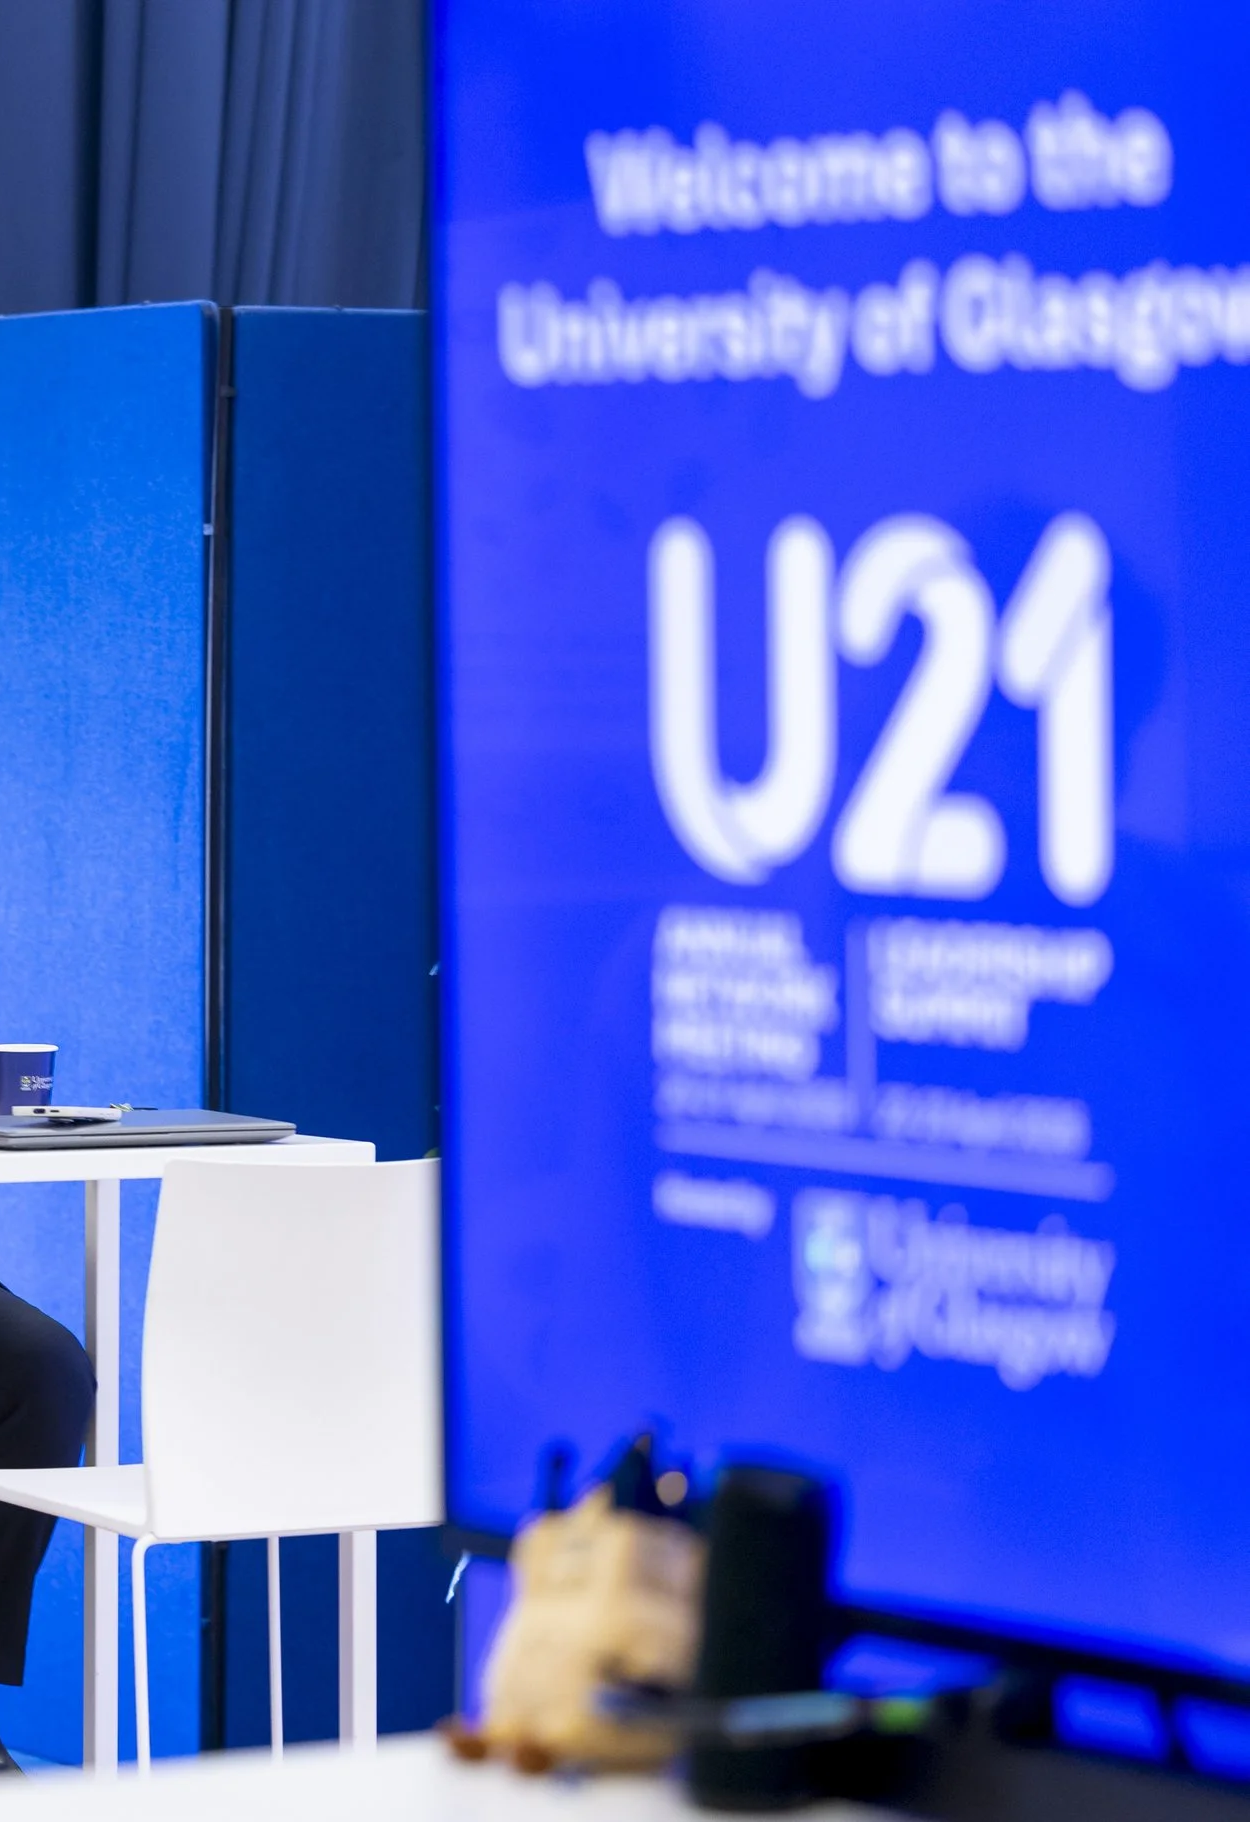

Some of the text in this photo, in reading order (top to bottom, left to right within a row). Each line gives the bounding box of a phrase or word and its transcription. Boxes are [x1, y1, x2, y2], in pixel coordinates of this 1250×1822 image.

[588, 91, 1171, 234] Welcome to the
[499, 268, 846, 396] University
[853, 260, 938, 374] of
[650, 514, 1112, 906] U21
